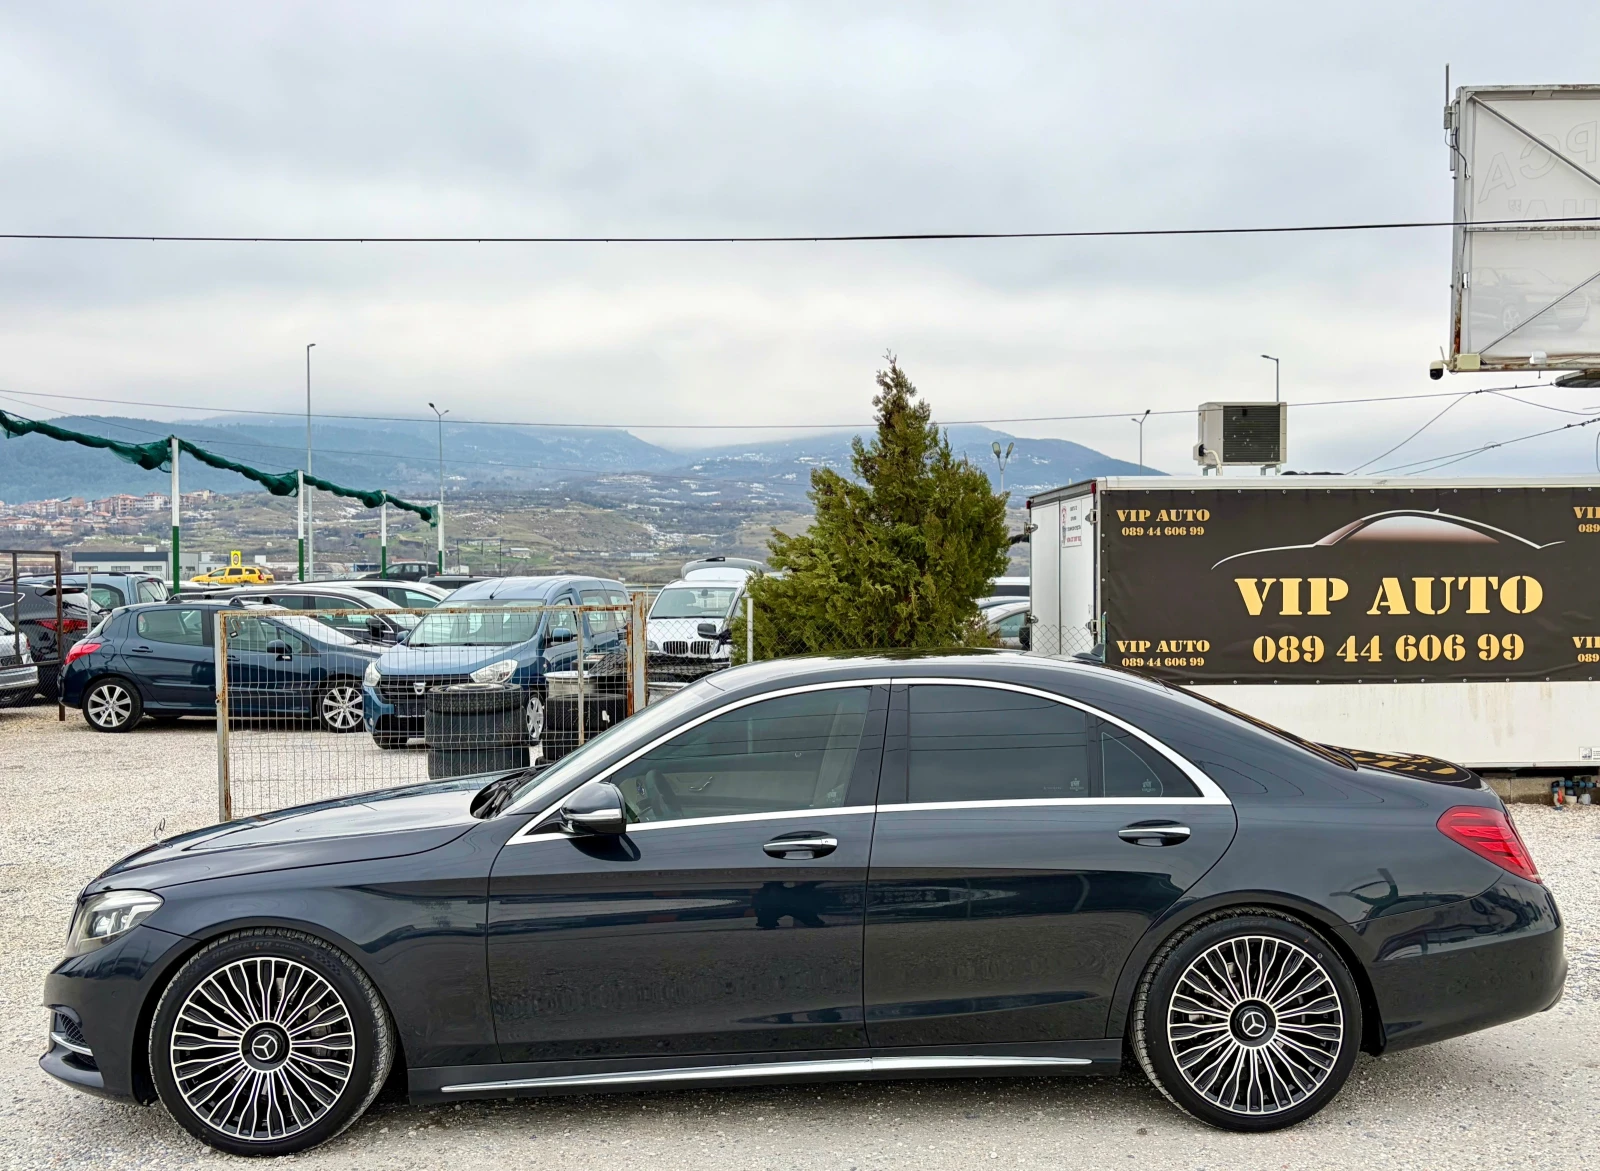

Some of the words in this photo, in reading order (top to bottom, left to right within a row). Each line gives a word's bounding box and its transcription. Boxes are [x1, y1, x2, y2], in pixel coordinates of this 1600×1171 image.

[1116, 509, 1151, 522] VIP
[1156, 508, 1210, 522] AUTO
[1121, 527, 1144, 536] 089
[1147, 527, 1161, 536] 44
[1164, 527, 1187, 536] 606
[1189, 527, 1205, 536] 99
[1578, 523, 1600, 533] 089
[1233, 577, 1349, 616] VIP
[1366, 575, 1544, 616] AUTO
[1116, 640, 1151, 653] VIP
[1156, 639, 1210, 653] AUTO
[1252, 635, 1325, 664] 089
[1335, 635, 1383, 663] 44
[1395, 634, 1466, 662] 606
[1477, 633, 1525, 662] 99
[1121, 657, 1145, 667] 089
[1147, 657, 1161, 667] 44
[1164, 657, 1187, 667] 606
[1189, 657, 1205, 667] 99
[1577, 653, 1600, 663] 089
